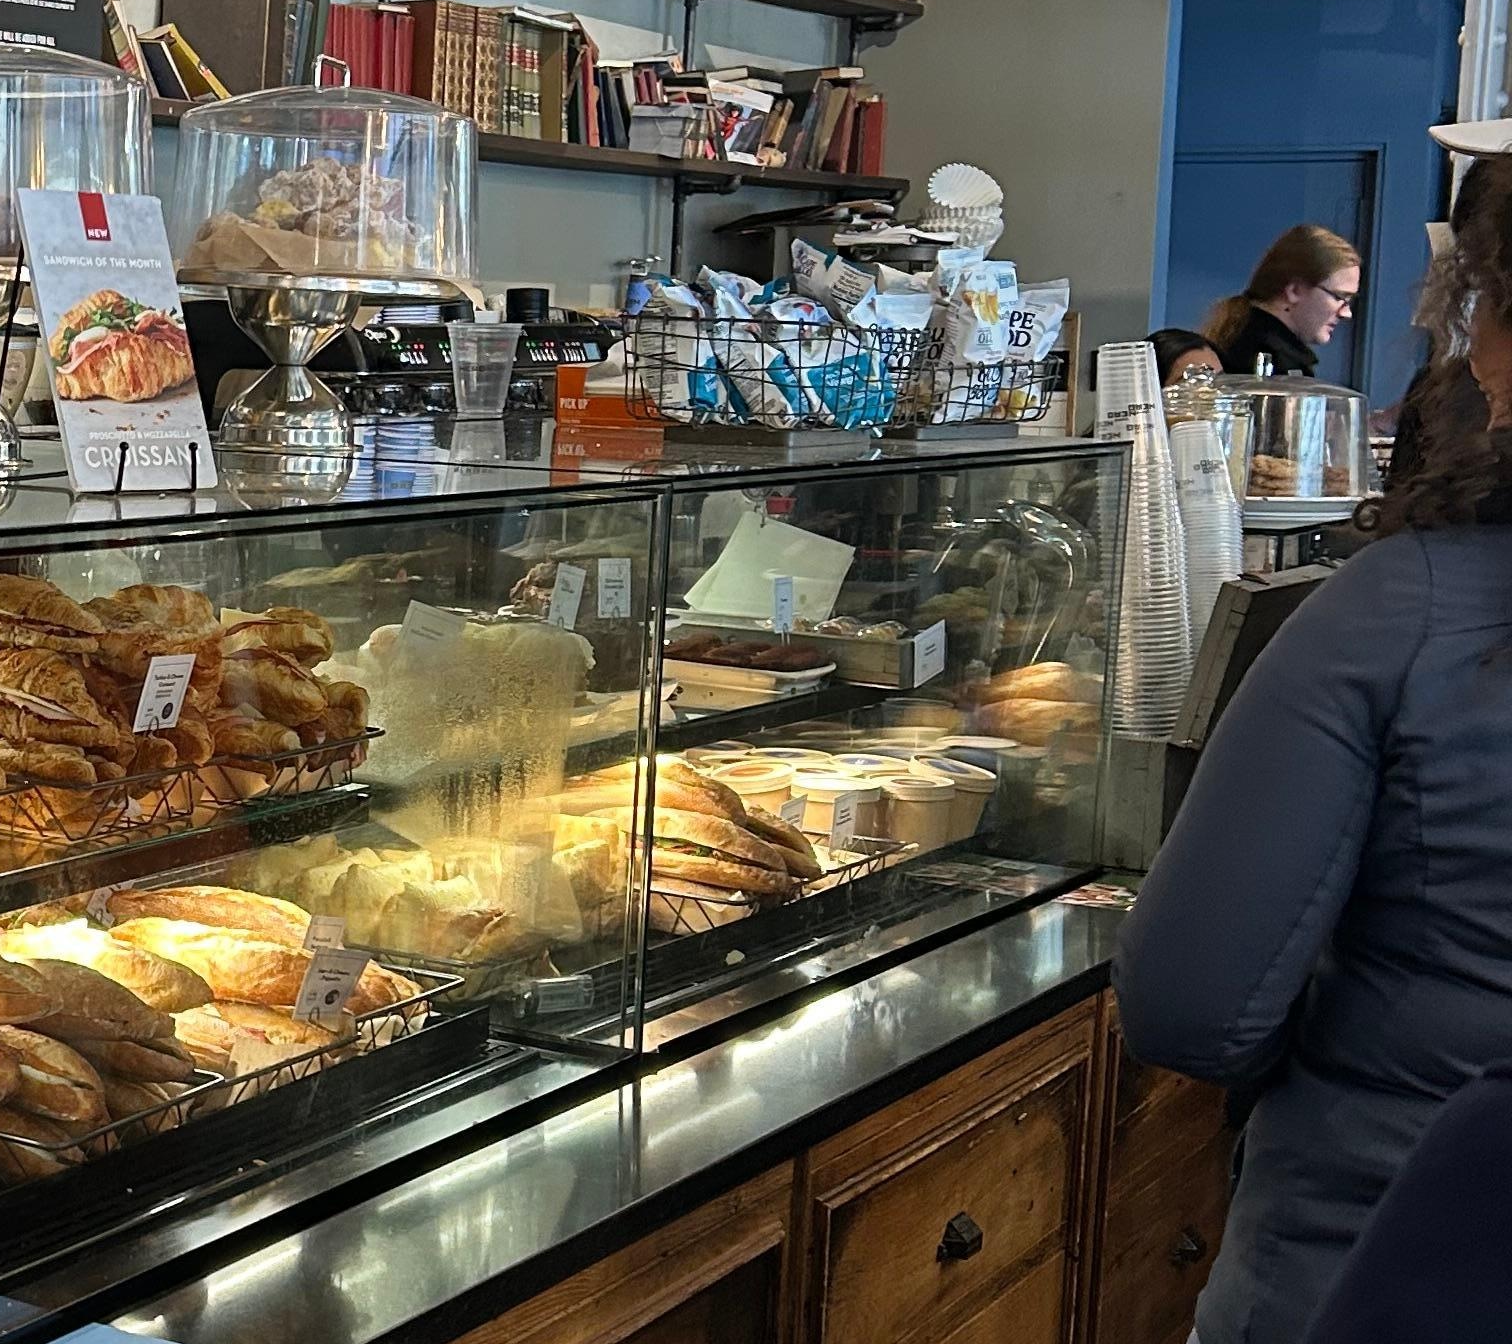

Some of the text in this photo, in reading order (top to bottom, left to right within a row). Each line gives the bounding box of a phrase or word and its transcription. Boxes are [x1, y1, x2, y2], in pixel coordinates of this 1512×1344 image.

[87, 228, 108, 238] NEW
[43, 255, 162, 269] SANDWICH OF THE MONTH
